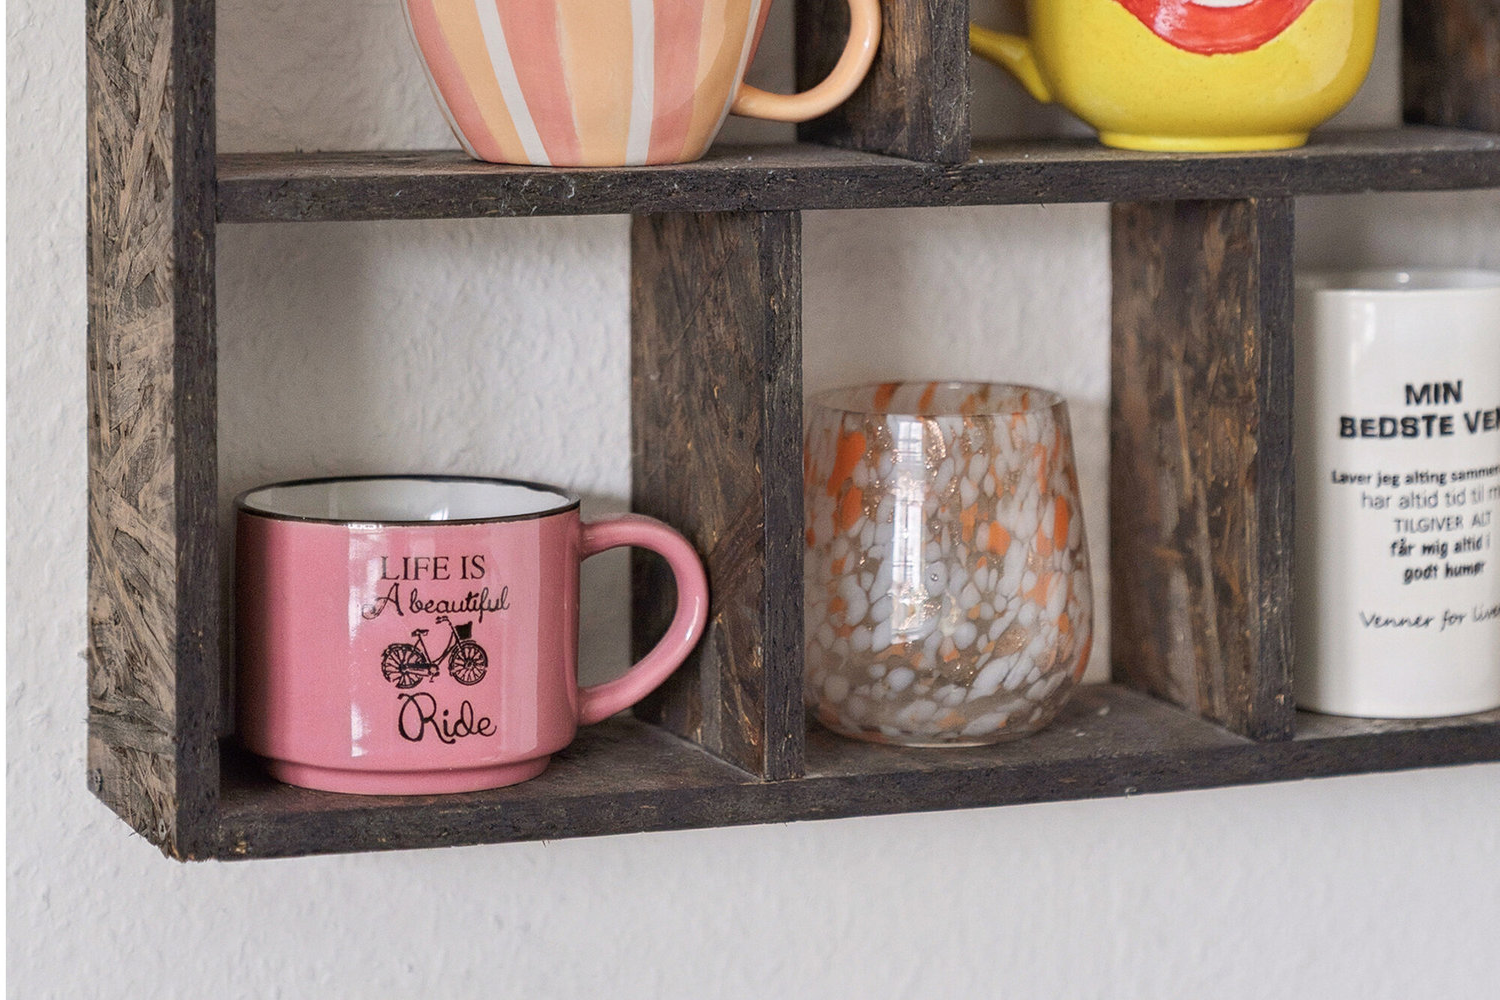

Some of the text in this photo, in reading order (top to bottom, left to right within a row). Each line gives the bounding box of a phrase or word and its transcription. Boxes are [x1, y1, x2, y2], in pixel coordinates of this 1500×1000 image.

[1405, 380, 1462, 404] MIN
[1340, 414, 1454, 438] BEDSTE
[1376, 470, 1399, 487] jeg
[1405, 470, 1446, 486] alting
[1361, 491, 1390, 509] har
[1399, 489, 1438, 509] altid
[1445, 487, 1466, 507] tid
[1471, 482, 1485, 505] til
[1394, 510, 1492, 533] TILGIVER ALT
[1390, 537, 1414, 556] får
[1422, 540, 1448, 559] mig
[1454, 534, 1483, 553] altid
[381, 554, 486, 581] LIFE IS
[1403, 561, 1485, 585] godt humør
[361, 582, 511, 623] A beautiful
[1359, 602, 1500, 633] Venner for live
[398, 692, 498, 744] Ride
